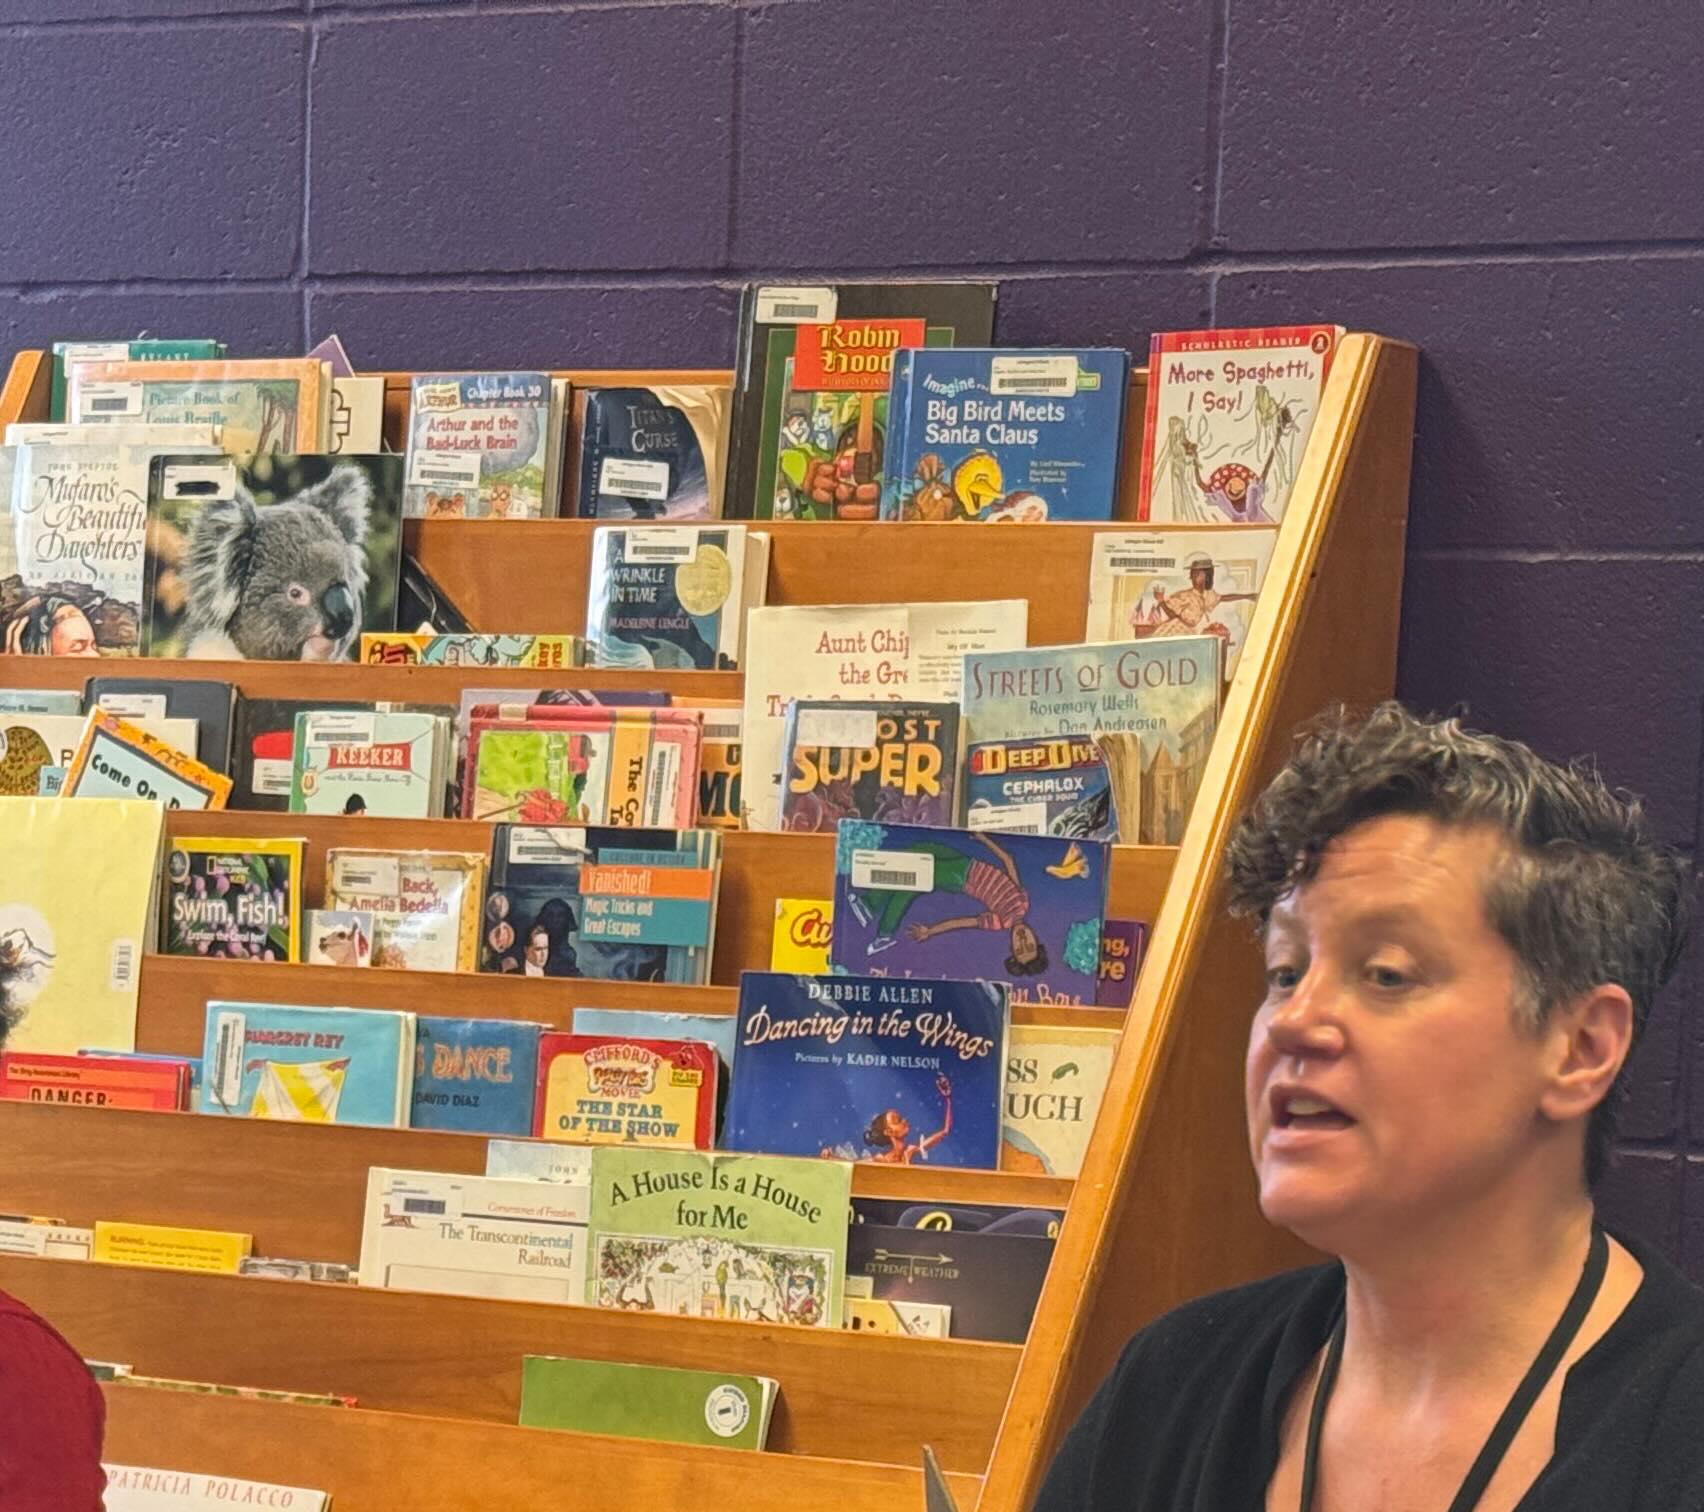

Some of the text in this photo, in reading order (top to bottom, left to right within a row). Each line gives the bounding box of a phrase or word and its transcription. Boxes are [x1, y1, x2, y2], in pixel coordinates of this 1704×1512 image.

[817, 324, 900, 348] Robin
[1181, 337, 1301, 350] SCHOLASTIC READER
[1168, 360, 1314, 385] More Spaghetti,
[504, 386, 525, 398] Book
[1187, 391, 1243, 413] I Say!
[427, 415, 518, 432] Arthur and the
[927, 400, 1065, 426] Big Bird Meets
[426, 435, 517, 450] Bad-Luck Brain
[925, 423, 1039, 445] Santa Claus
[43, 500, 146, 538] Beautifu
[36, 529, 142, 577] Daughters
[609, 567, 665, 583] WRINKLE
[612, 586, 658, 602] IN TIME
[815, 630, 867, 654] Aunt
[839, 662, 871, 684] the
[876, 661, 908, 684] Gre
[973, 661, 1064, 699] STREETS
[1077, 664, 1104, 690] OF
[1116, 650, 1198, 689] GOLD
[1029, 693, 1139, 716] Rosemary Wells
[877, 719, 942, 741] OST
[1093, 717, 1167, 732] Andreasen
[336, 746, 404, 766] KEEKER
[982, 740, 1100, 775] DEEP DIVE
[91, 754, 131, 787] Come
[627, 757, 643, 792] The
[789, 743, 942, 797] SUPER
[1002, 776, 1085, 796] CEPHALOX
[402, 877, 439, 897] Back,
[588, 867, 652, 895] Vanished!
[174, 891, 285, 927] Swim, Fish!
[350, 895, 449, 914] Amelia Bedelia
[585, 897, 653, 916] Magic Tricks and
[584, 917, 641, 938] Great Escapes
[808, 984, 934, 1004] DEBBIE ALLEN
[313, 1032, 345, 1049] REY
[743, 1005, 994, 1060] Dancing in the Wings
[432, 1042, 513, 1083] DANCE
[584, 1044, 663, 1070] CLIFFORD'S
[795, 1052, 940, 1069] Pictures by KADIR NELSON
[601, 1087, 641, 1098] MOVIE
[577, 1099, 663, 1119] THE STAR
[1007, 1092, 1084, 1121] UCH
[559, 1115, 680, 1138] OF THE SHOW
[610, 1166, 822, 1224] A House Is a House
[677, 1200, 748, 1229] for Me
[439, 1222, 573, 1249] The Transcontinental
[518, 1249, 571, 1269] Railroad
[865, 1263, 960, 1279] EXTREME WEATHER
[110, 1470, 294, 1508] PATRICIA POLACCO
